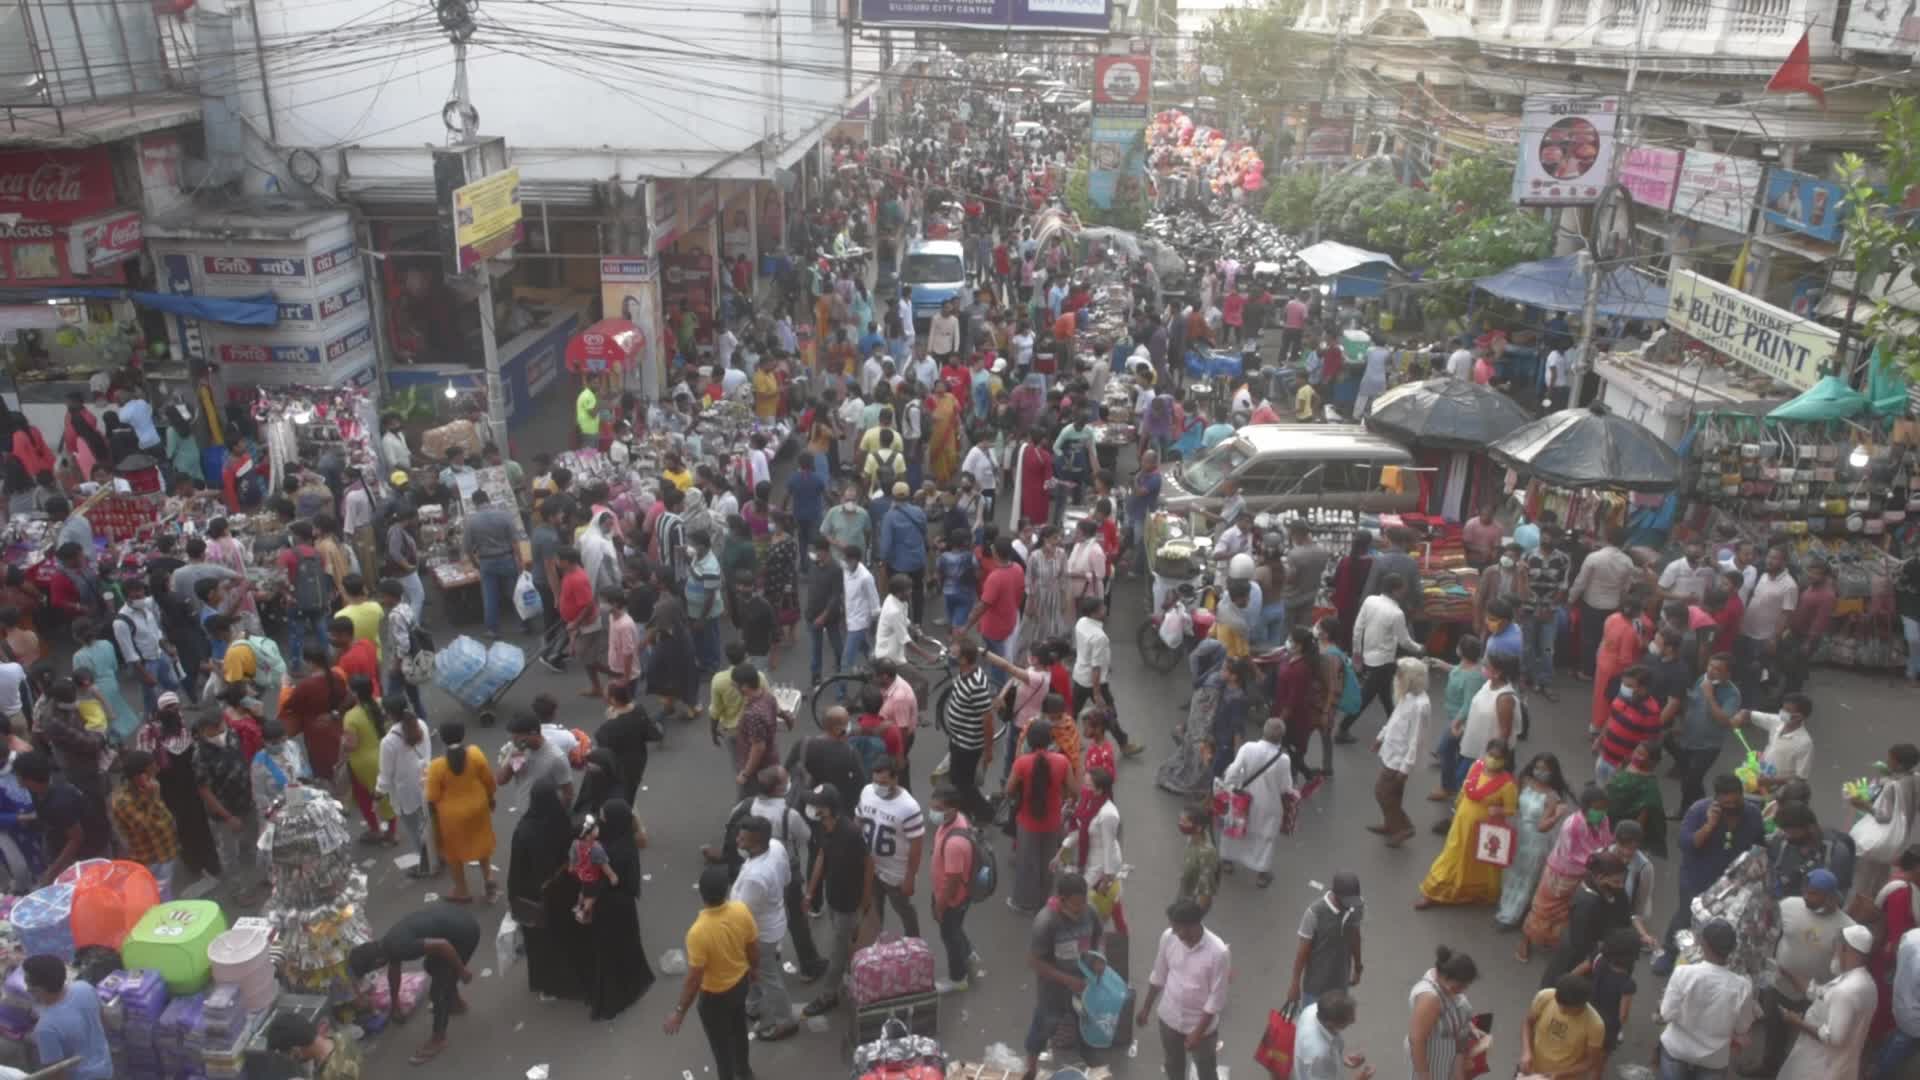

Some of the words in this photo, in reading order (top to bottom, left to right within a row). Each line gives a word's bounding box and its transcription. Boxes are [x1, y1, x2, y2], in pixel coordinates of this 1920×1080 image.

[932, 4, 953, 13] CITY
[956, 6, 993, 14] CENTRE
[1689, 297, 1738, 339] BLUE
[1743, 323, 1811, 371] PRINT
[1712, 291, 1737, 313] NEW
[1742, 304, 1793, 335] MARKET
